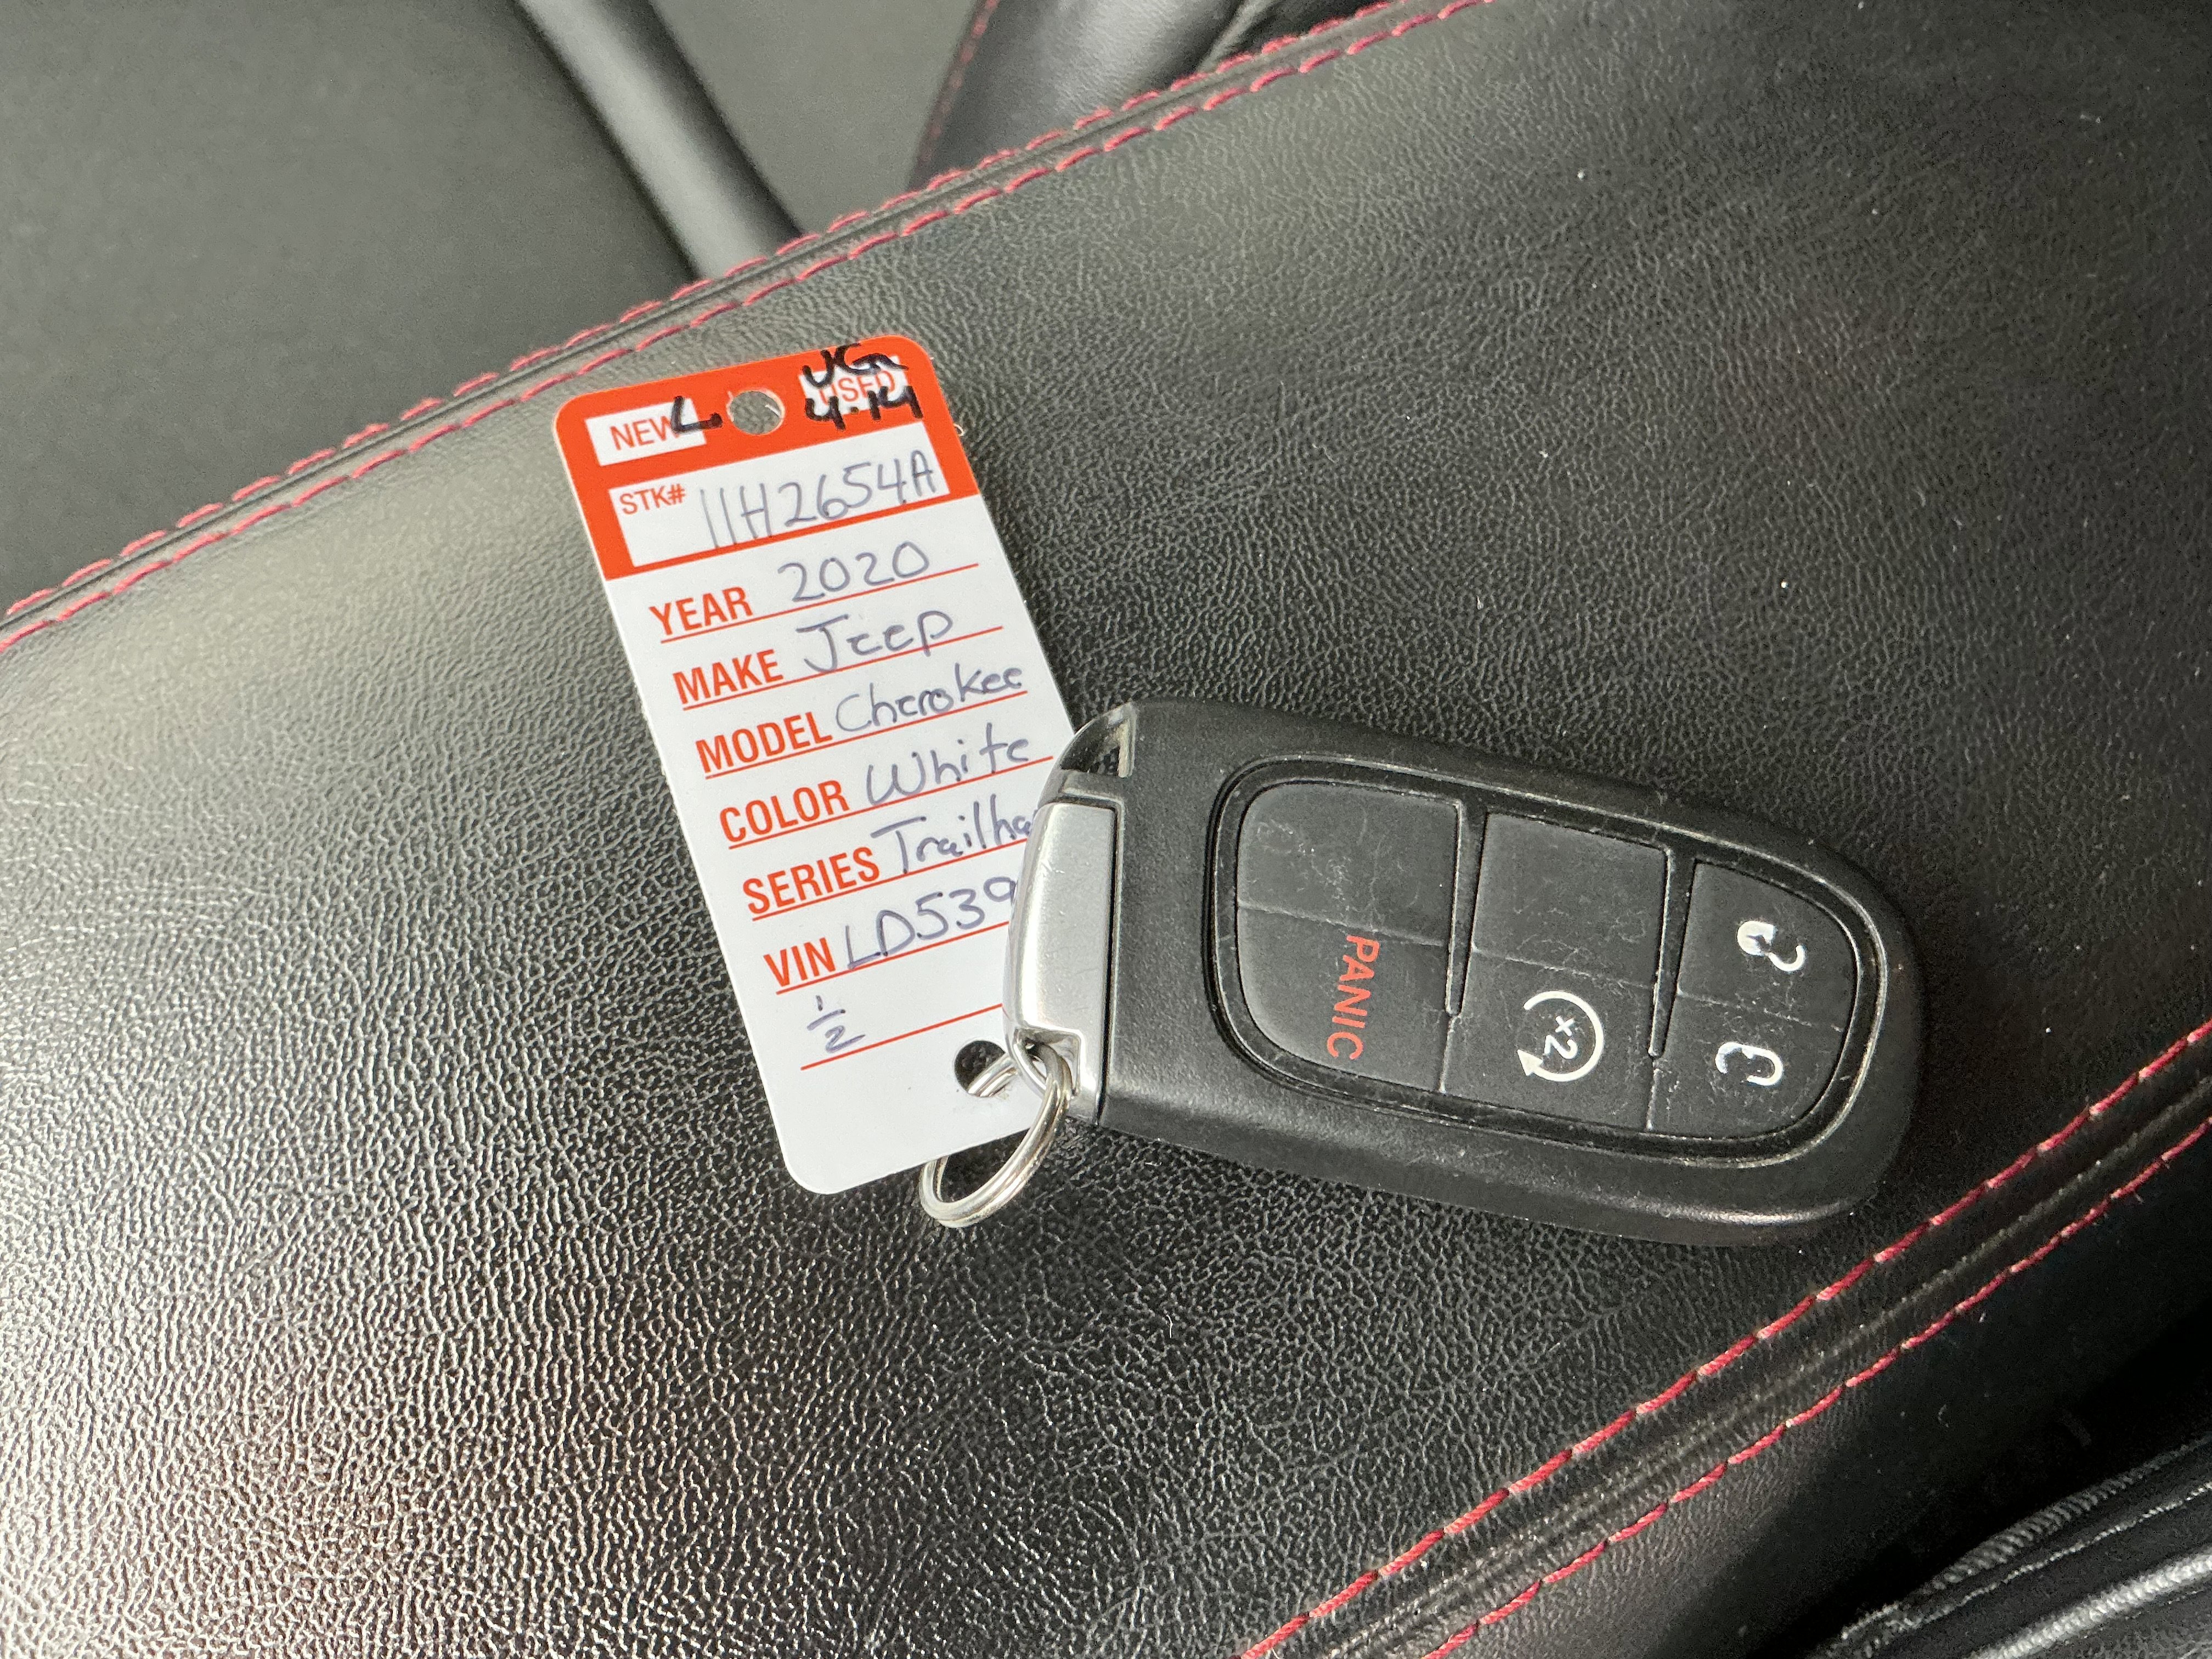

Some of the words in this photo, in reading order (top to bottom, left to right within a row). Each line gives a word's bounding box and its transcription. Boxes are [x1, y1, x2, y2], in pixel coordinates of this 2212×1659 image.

[819, 370, 895, 406] USED
[619, 483, 686, 515] STK#
[777, 540, 930, 603] 2020
[648, 586, 753, 636] YEAR
[795, 610, 954, 674] Jeep
[672, 648, 784, 704] MAKE
[835, 663, 1023, 733] Cherokee
[695, 712, 833, 774] MODEL
[866, 722, 1030, 807] White
[719, 780, 850, 843] COLOR
[871, 793, 1039, 874] Trailha
[742, 846, 881, 915] SERIES
[763, 936, 836, 988] VIN
[1327, 934, 1380, 1060] PANIC
